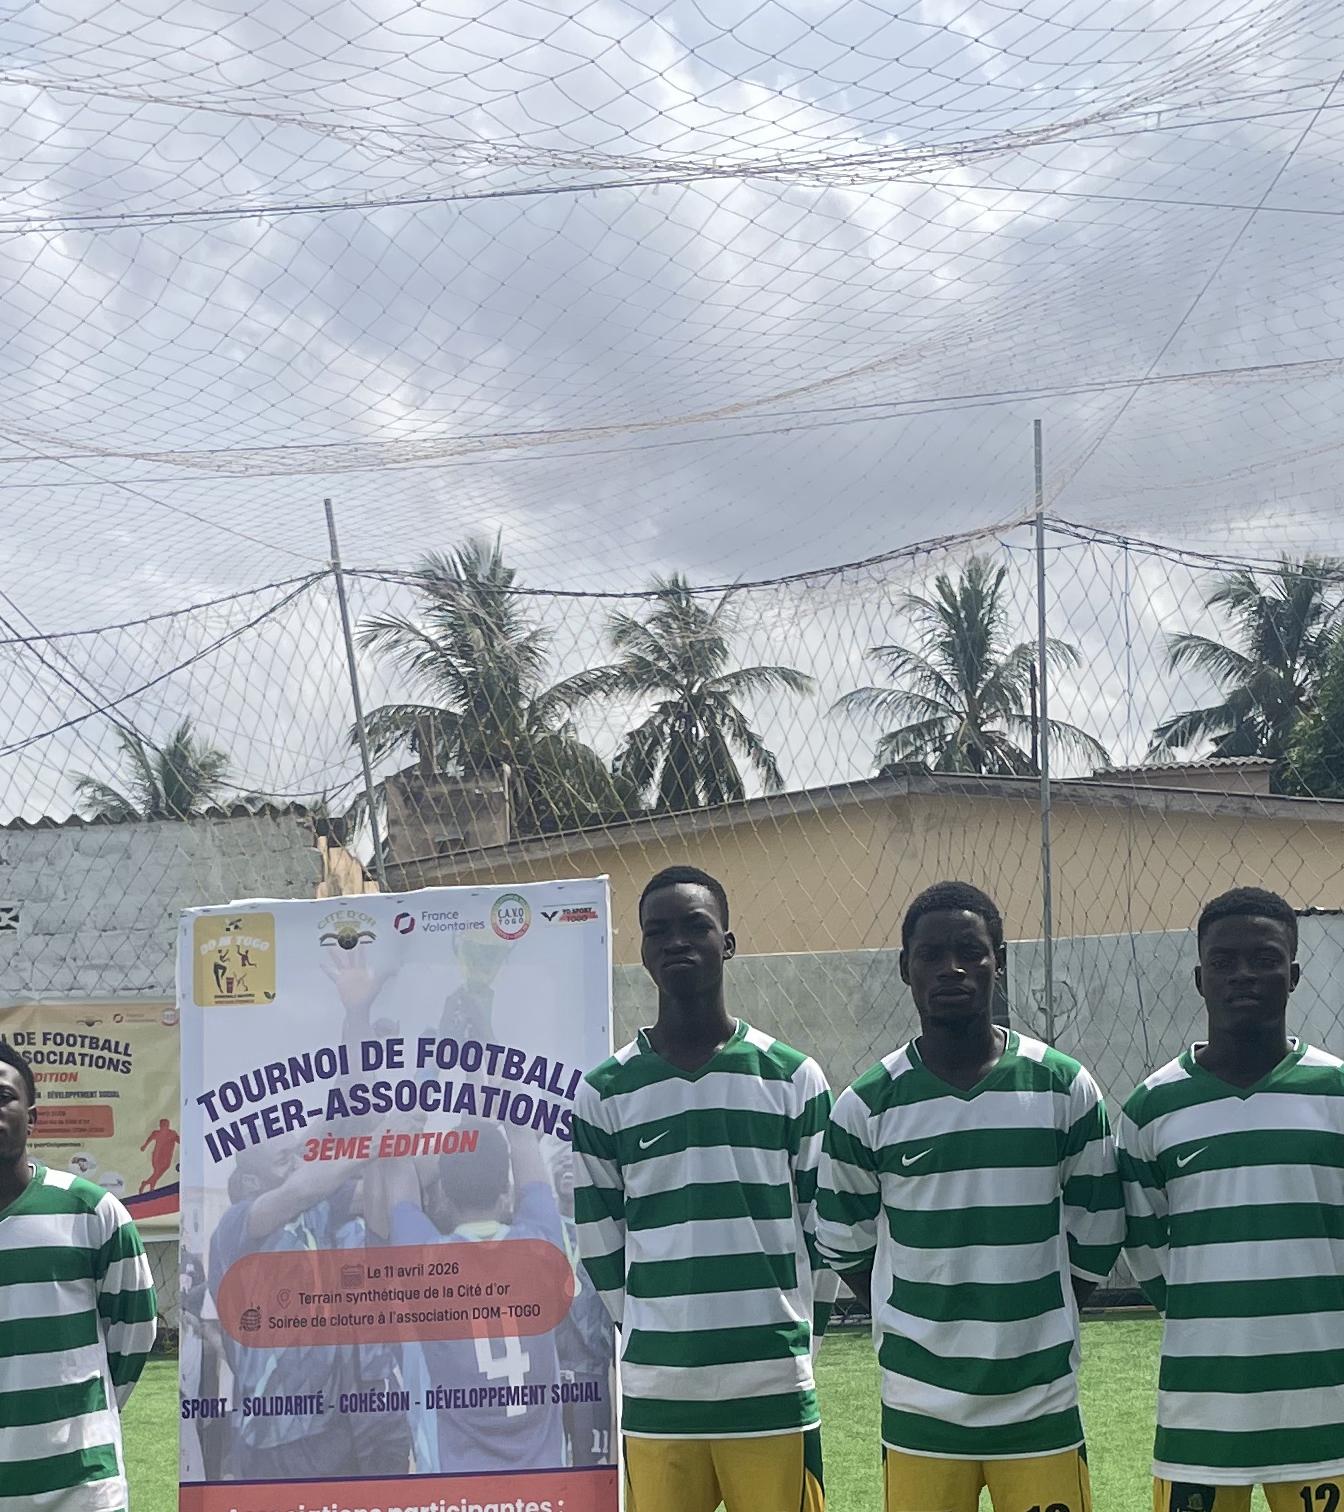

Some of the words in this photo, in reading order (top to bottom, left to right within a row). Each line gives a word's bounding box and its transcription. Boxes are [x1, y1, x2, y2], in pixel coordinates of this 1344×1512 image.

[421, 911, 459, 921] France
[13, 1031, 36, 1046] DE
[42, 1031, 133, 1058] FOOTBALL
[34, 1071, 79, 1083] DITION
[196, 1044, 349, 1122] TOURNOI
[361, 1038, 404, 1072] DE
[416, 1037, 582, 1101] FOOTBALL
[204, 1079, 572, 1163] INTER-ASSOCIATIONS
[303, 1132, 372, 1162] 3ÈME
[378, 1129, 479, 1158] ÉDITION
[367, 1266, 381, 1279] Le
[383, 1265, 394, 1278] 11
[397, 1263, 424, 1278] avril
[427, 1262, 459, 1276] 2026
[298, 1291, 342, 1305] Terrain
[345, 1287, 420, 1304] synthétique
[423, 1285, 439, 1299] de
[442, 1285, 454, 1298] la
[457, 1283, 482, 1297] Cité
[485, 1282, 510, 1296] d'or
[268, 1314, 307, 1329] Soirée
[311, 1314, 327, 1327] de
[330, 1312, 374, 1327] cloture
[377, 1310, 386, 1324] à
[389, 1307, 468, 1324] l'association
[472, 1304, 541, 1320] DOM-TOGO
[181, 1398, 228, 1419] SPORT
[242, 1389, 324, 1417] SOLIDARITÉ
[339, 1387, 410, 1414] COHÉSION
[425, 1384, 547, 1412] DÉVELOPPEMENT
[551, 1381, 602, 1405] SOCIAL
